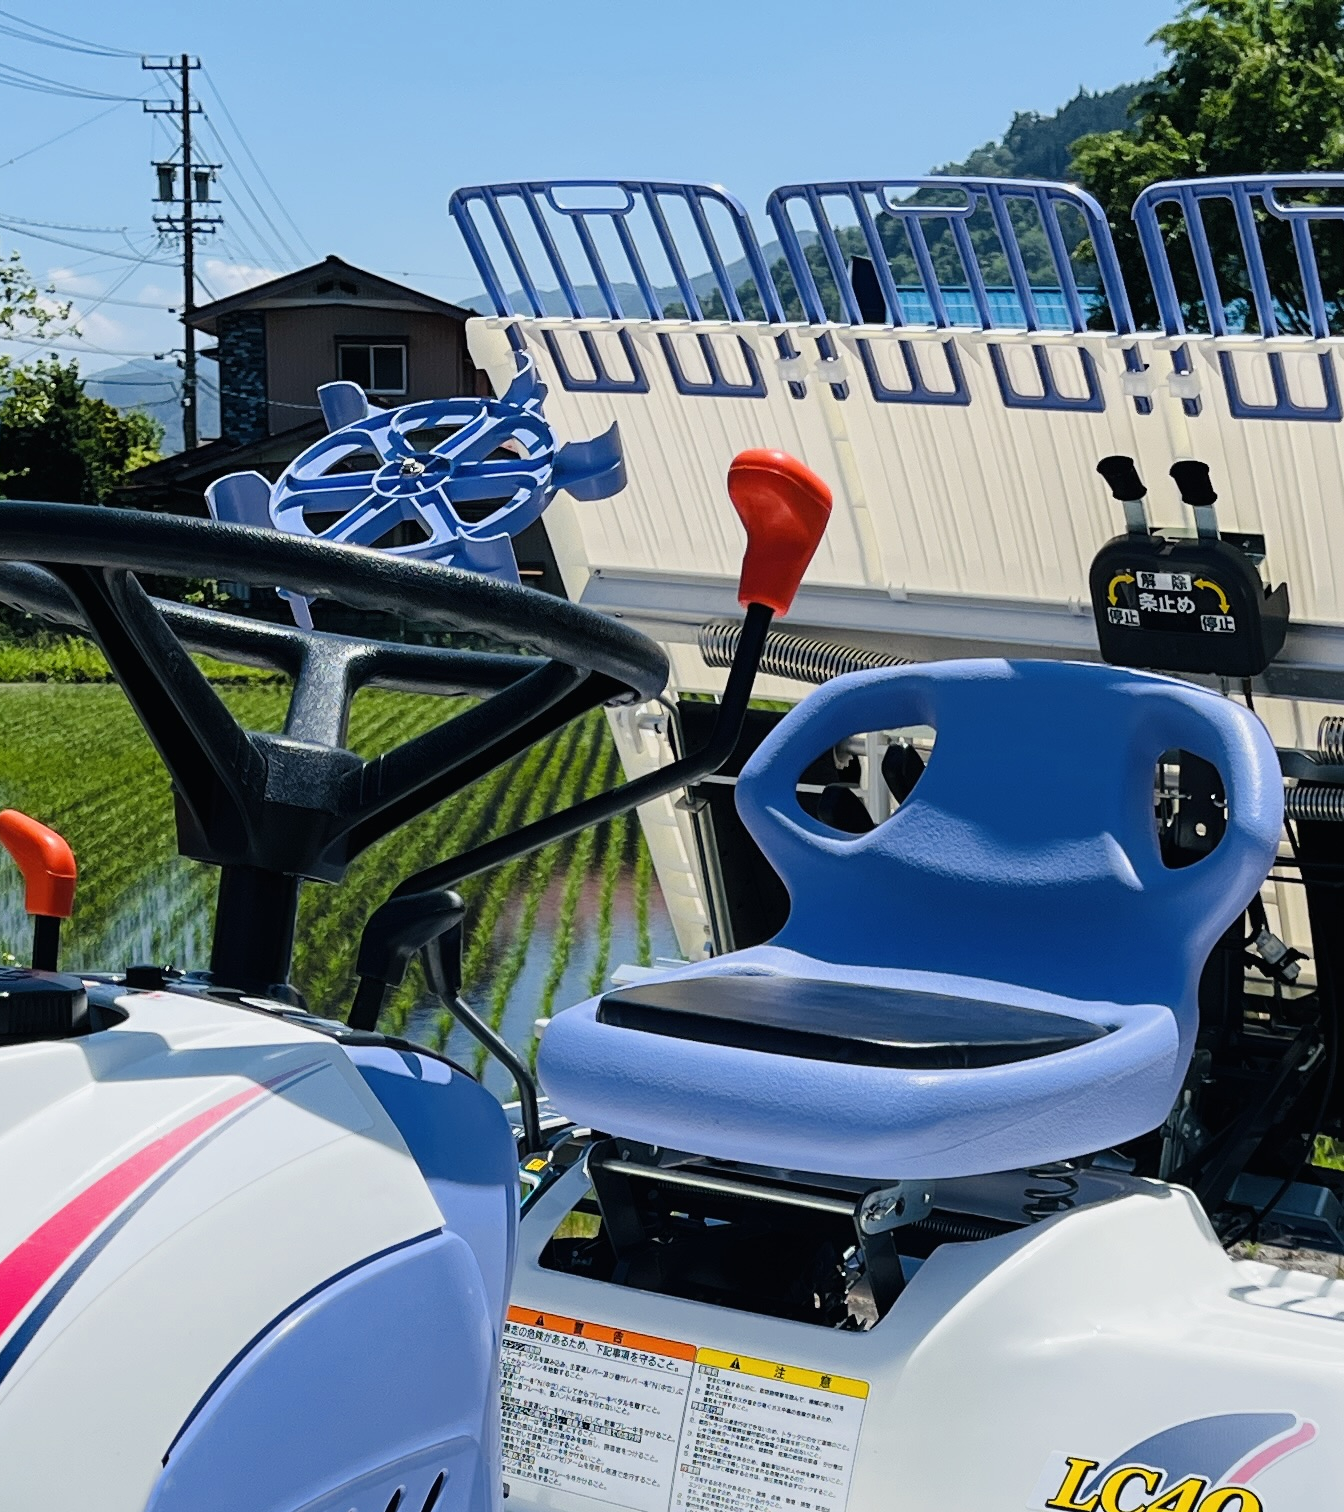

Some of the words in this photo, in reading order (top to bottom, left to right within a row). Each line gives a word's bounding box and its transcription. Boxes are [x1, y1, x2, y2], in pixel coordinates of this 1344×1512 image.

[1141, 573, 1187, 590] 解除
[1139, 593, 1196, 614] 条止め
[1109, 609, 1140, 626] 停止
[1202, 616, 1236, 632] 停止
